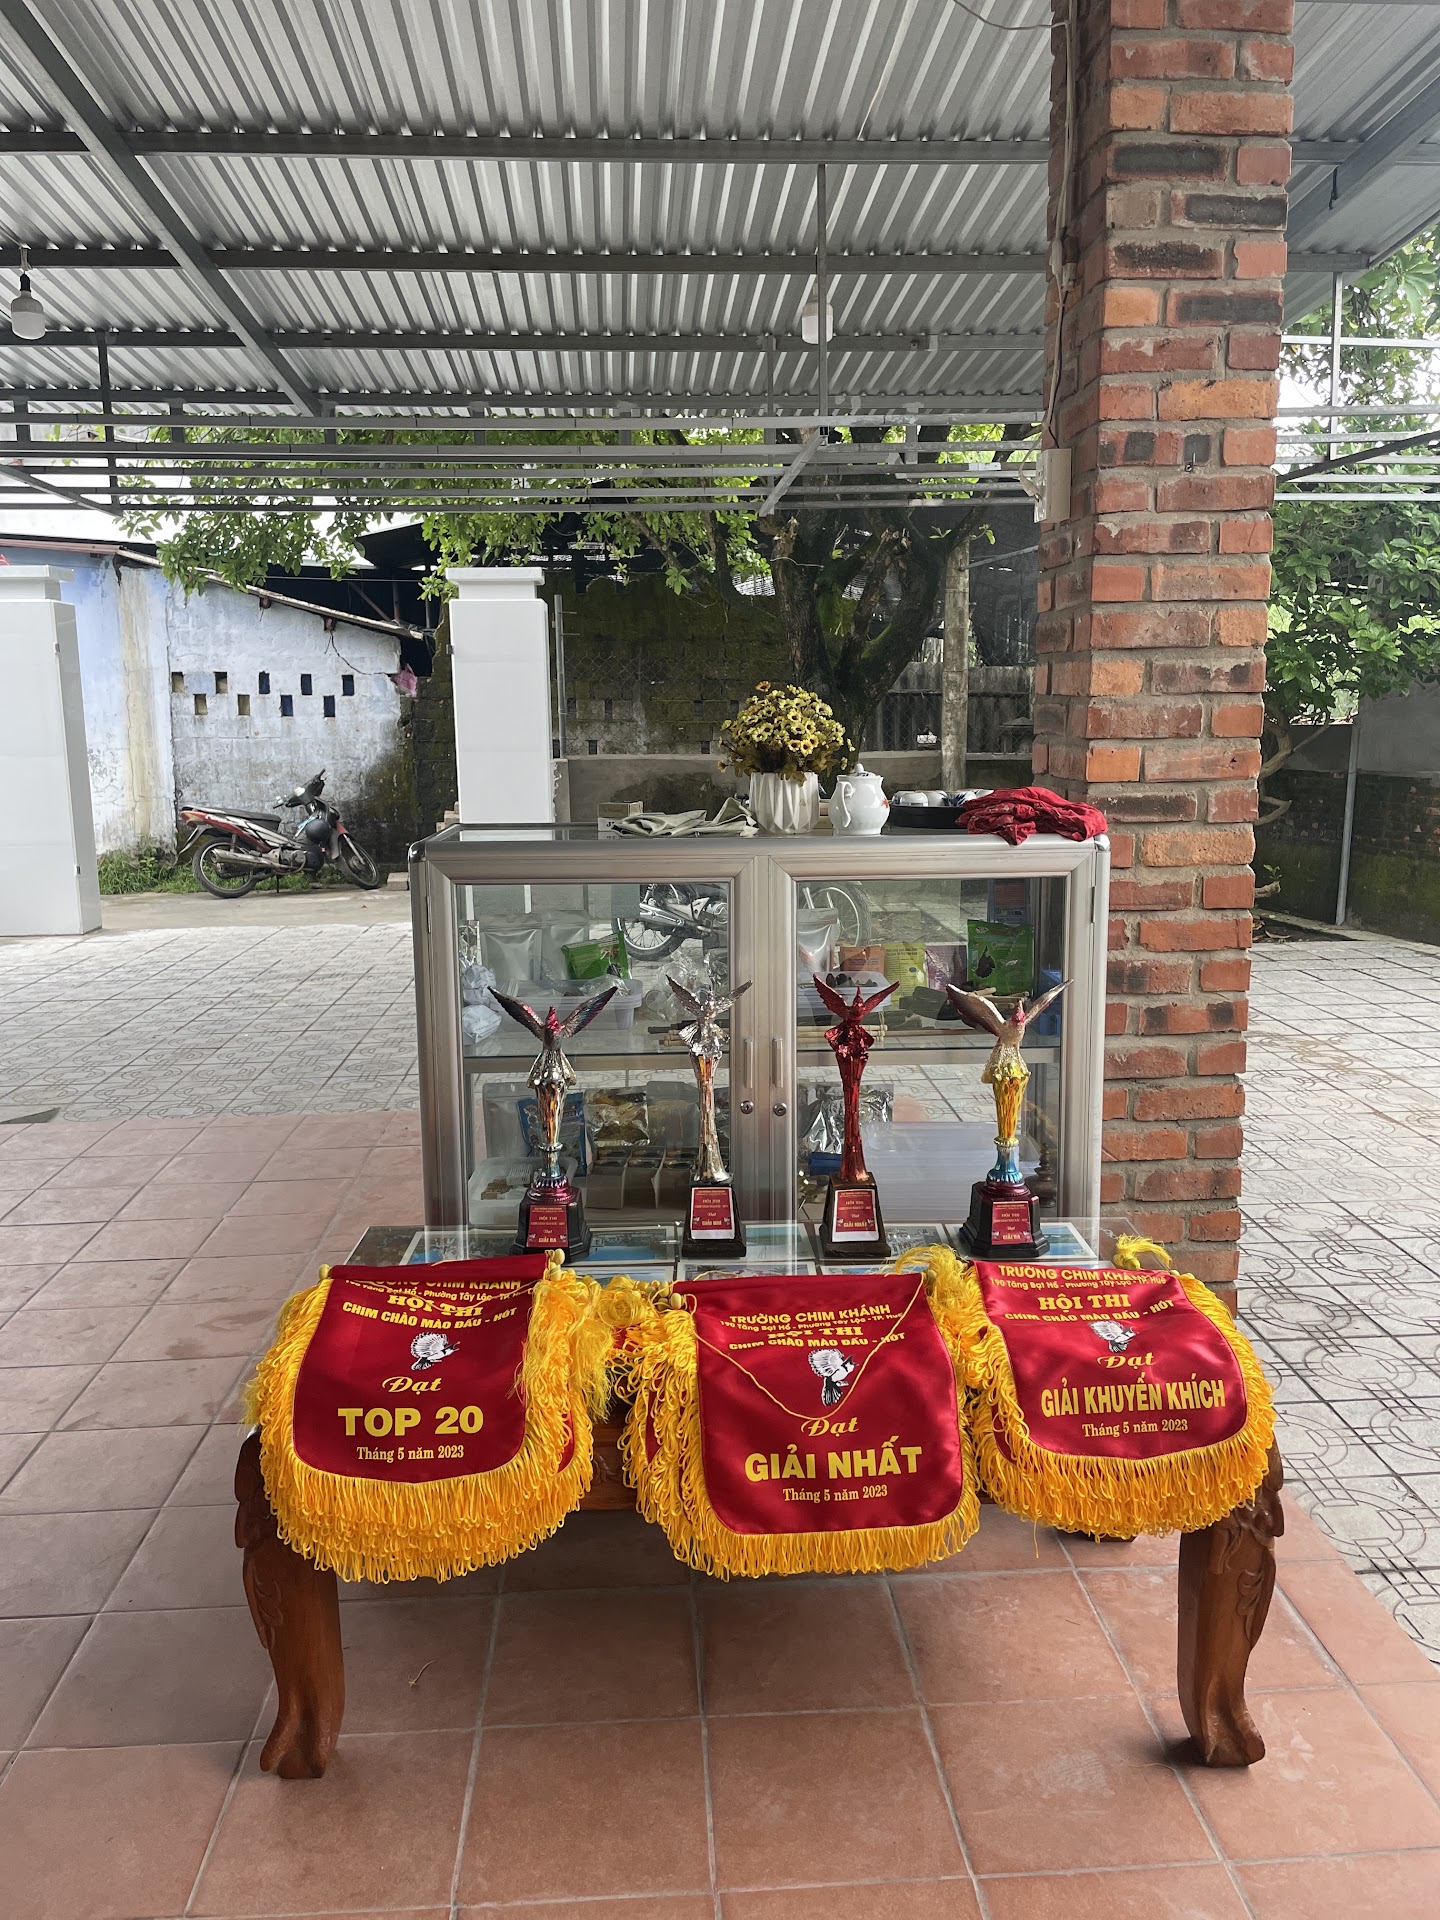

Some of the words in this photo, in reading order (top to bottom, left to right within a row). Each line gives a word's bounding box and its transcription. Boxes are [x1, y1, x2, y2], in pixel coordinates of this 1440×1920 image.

[990, 1278, 1005, 1286] 190
[998, 1265, 1058, 1280] TRƯỜNG
[1061, 1270, 1100, 1280] CHIM
[424, 1290, 457, 1301] Phường
[460, 1292, 475, 1302] Tây
[1037, 1293, 1083, 1312] HỘI
[1087, 1294, 1131, 1308] THI
[343, 1302, 378, 1318] CHIM
[381, 1312, 417, 1327] CHÀO
[420, 1319, 452, 1329] MÀO
[454, 1317, 482, 1329] ĐẤU
[493, 1307, 517, 1322] HÓT
[440, 1303, 483, 1316] THI
[730, 1313, 791, 1324] TRƯỜNG
[795, 1312, 835, 1322] CHIM
[839, 1304, 890, 1318] KHÁNH
[1042, 1314, 1078, 1322] CHÀO
[1080, 1313, 1110, 1321] MÀO
[818, 1327, 863, 1335] THI
[729, 1342, 764, 1350] CHIM
[768, 1338, 804, 1347] CHÀO
[808, 1338, 838, 1347] MÀO
[1097, 1352, 1155, 1369] Đạt
[382, 1376, 442, 1395] Đạt
[1041, 1377, 1079, 1417] GIẢI
[1083, 1372, 1162, 1414] KHUYẾN
[1166, 1373, 1226, 1410] KHÍCH
[338, 1408, 421, 1437] TOP
[435, 1405, 484, 1434] 20
[801, 1417, 859, 1437] Đạt
[1082, 1423, 1119, 1438] Tháng
[1123, 1421, 1130, 1434] 5
[1133, 1420, 1158, 1433] năm
[1162, 1419, 1188, 1431] 2023
[357, 1446, 394, 1463] Tháng
[398, 1447, 404, 1460] 5
[408, 1447, 434, 1460] năm
[438, 1445, 464, 1458] 2023
[744, 1444, 816, 1482] GIẢI
[828, 1436, 922, 1479] NHẤT
[783, 1488, 820, 1503] Tháng
[824, 1489, 830, 1501] 5
[834, 1488, 859, 1500] năm
[863, 1484, 888, 1498] 2023
